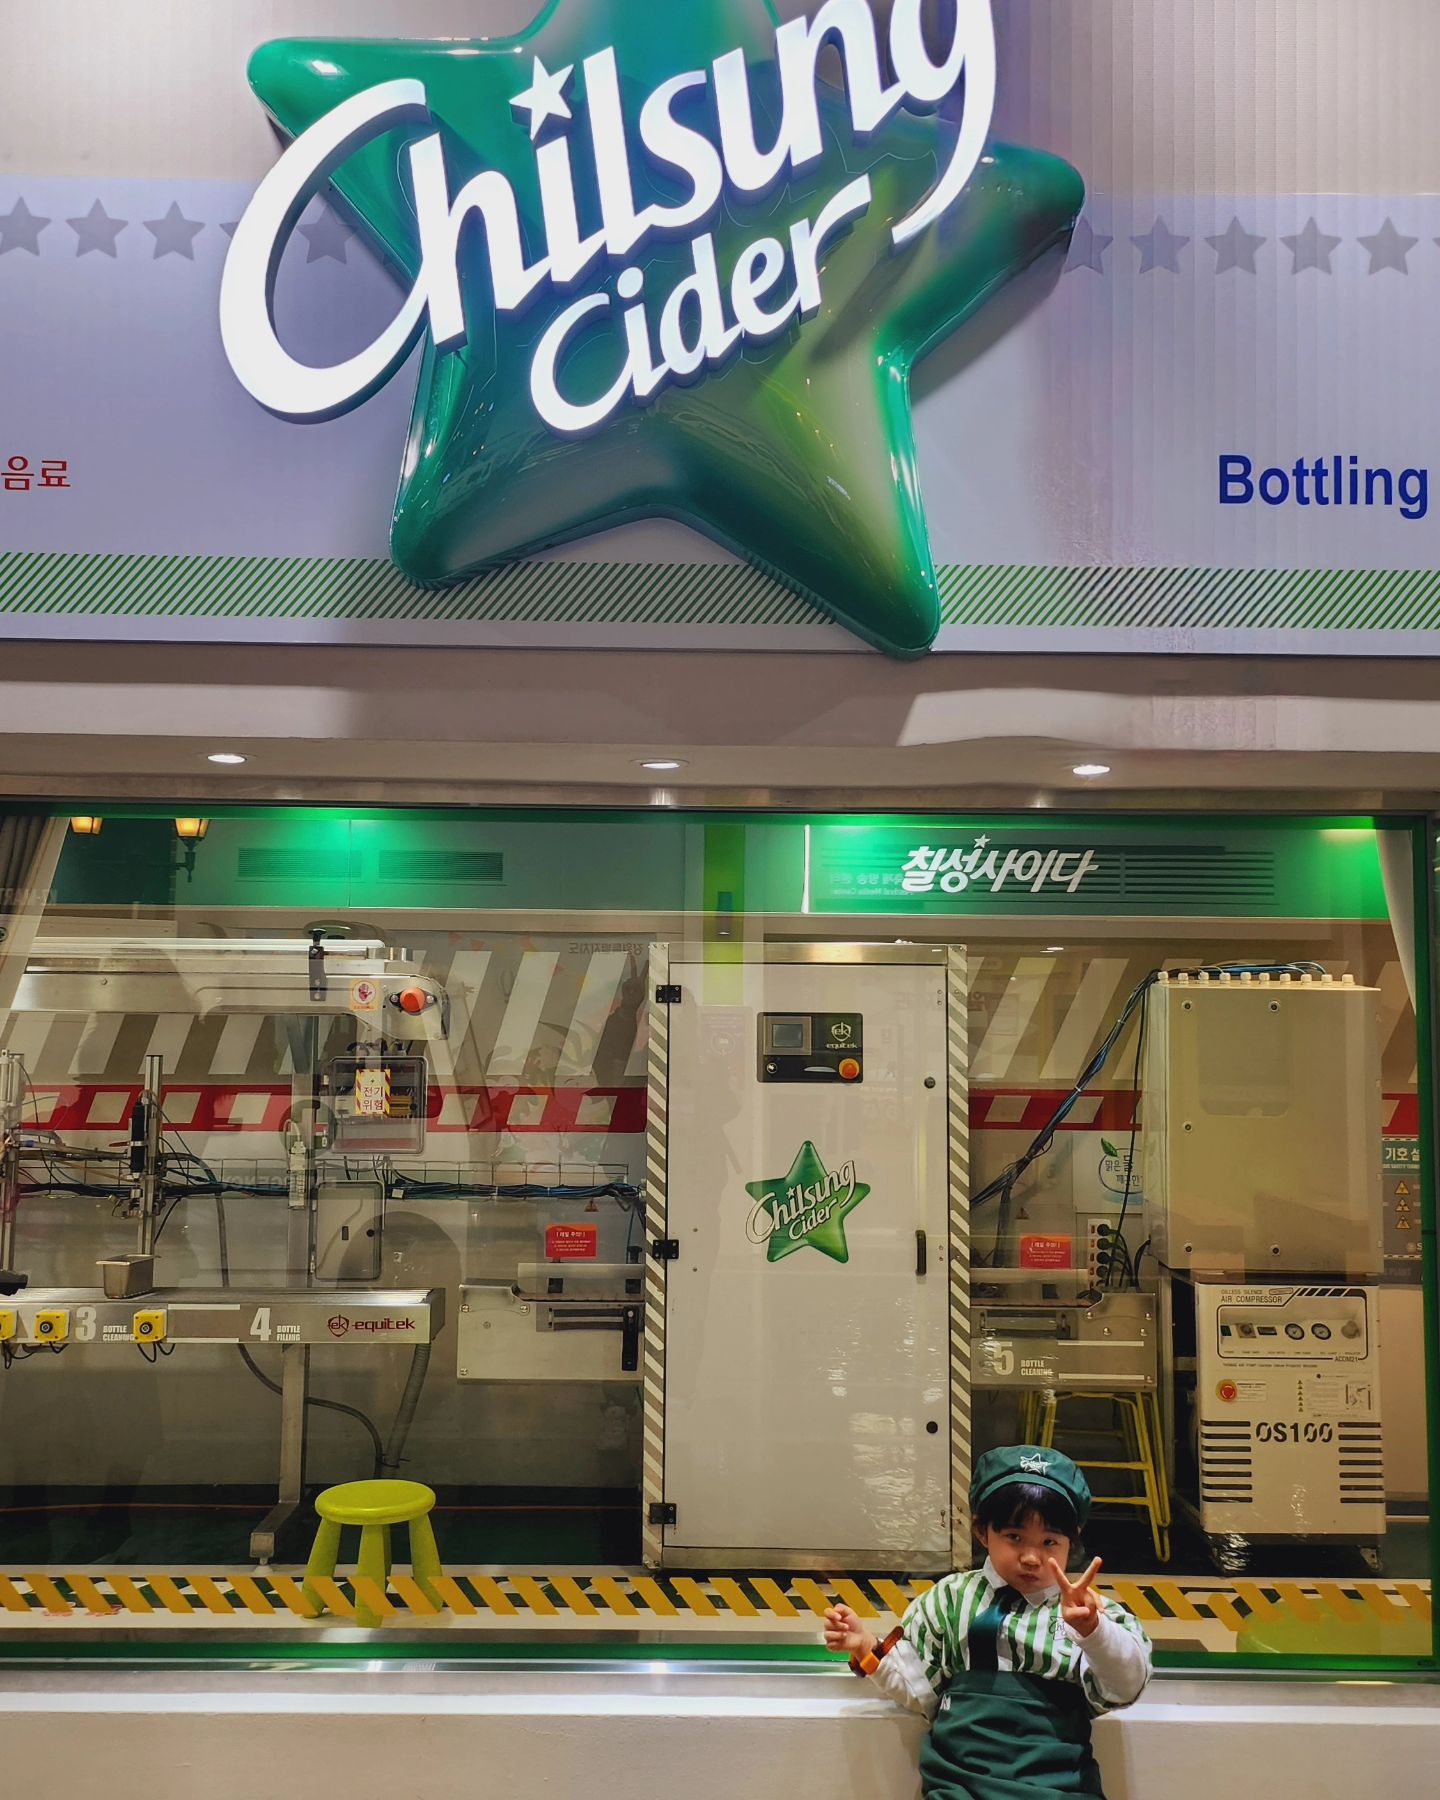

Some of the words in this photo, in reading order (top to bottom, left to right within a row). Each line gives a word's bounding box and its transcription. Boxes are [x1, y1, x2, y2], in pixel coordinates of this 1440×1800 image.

[219, 0, 998, 415] Chilsung
[1, 456, 71, 490] 음료
[1218, 455, 1429, 519] Bottling
[900, 845, 1100, 893] 칠성사이다
[363, 1086, 384, 1098] 전기
[362, 1100, 384, 1111] 위험
[1385, 1147, 1409, 1161] 기호
[1105, 1160, 1121, 1172] 맑은
[745, 1159, 857, 1245] Chilsung
[1221, 1295, 1233, 1304] AIR
[1236, 1295, 1283, 1304] COMPRESSOR
[75, 1306, 97, 1341] 3
[103, 1325, 128, 1333] BOTTLE
[250, 1307, 272, 1341] 4
[276, 1325, 301, 1333] BOTTLE
[352, 1317, 415, 1332] equitek
[103, 1334, 135, 1342] CLEANING
[276, 1333, 301, 1342] FILLING
[993, 1341, 1015, 1376] 5
[1020, 1359, 1045, 1368] BOTTLE
[1020, 1368, 1053, 1377] CLEANING
[1255, 1422, 1333, 1443] OS100
